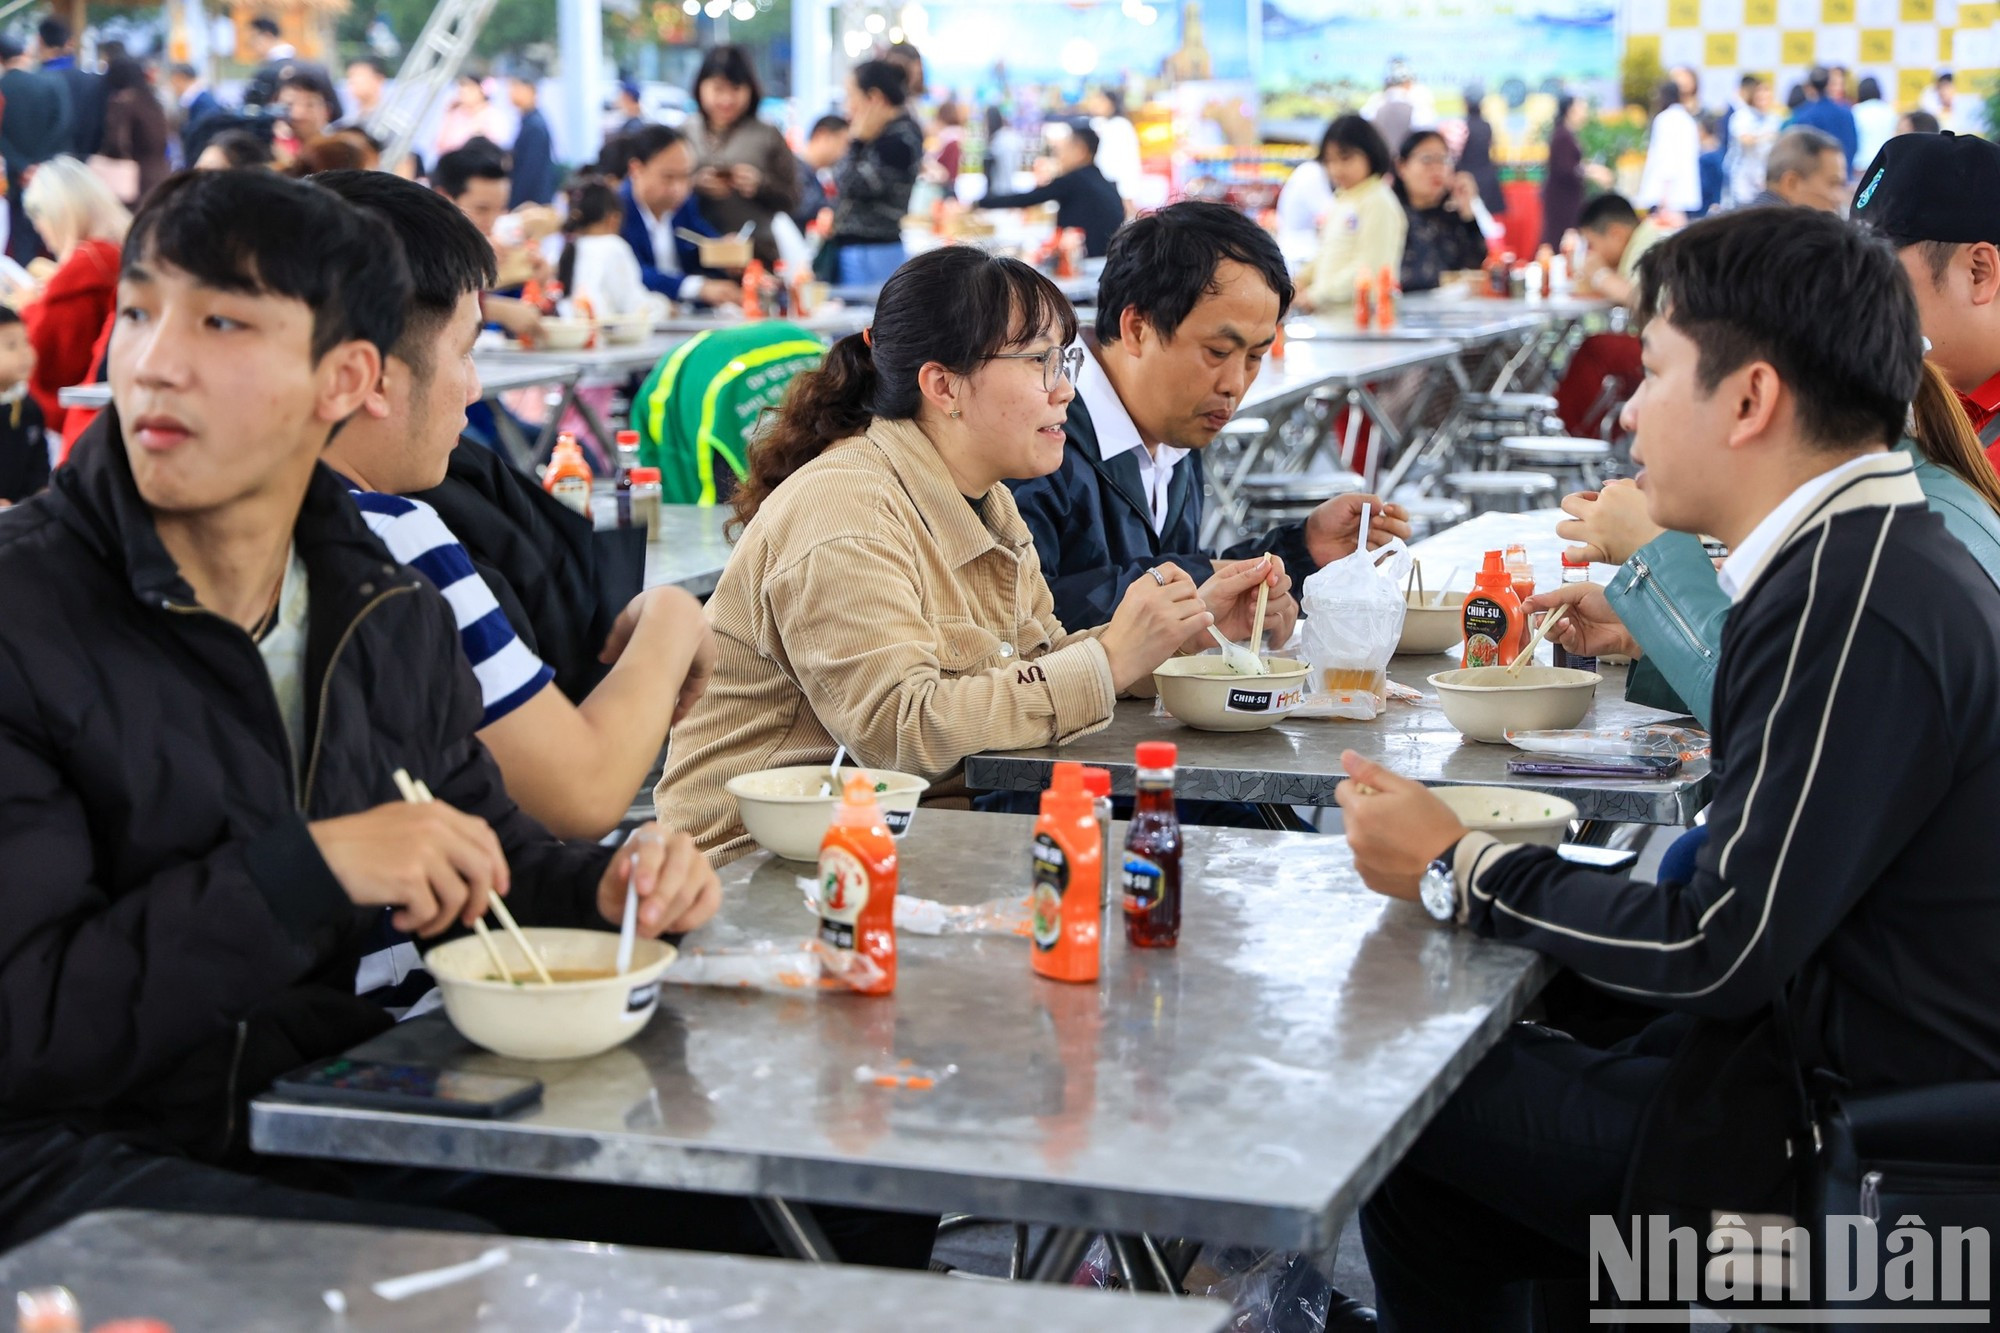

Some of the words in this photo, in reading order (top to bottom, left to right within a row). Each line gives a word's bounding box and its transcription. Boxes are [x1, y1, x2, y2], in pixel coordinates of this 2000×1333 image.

[1467, 606, 1500, 618] CHIN-SU
[1017, 665, 1047, 684] UY
[1233, 693, 1268, 704] CHIN-SU
